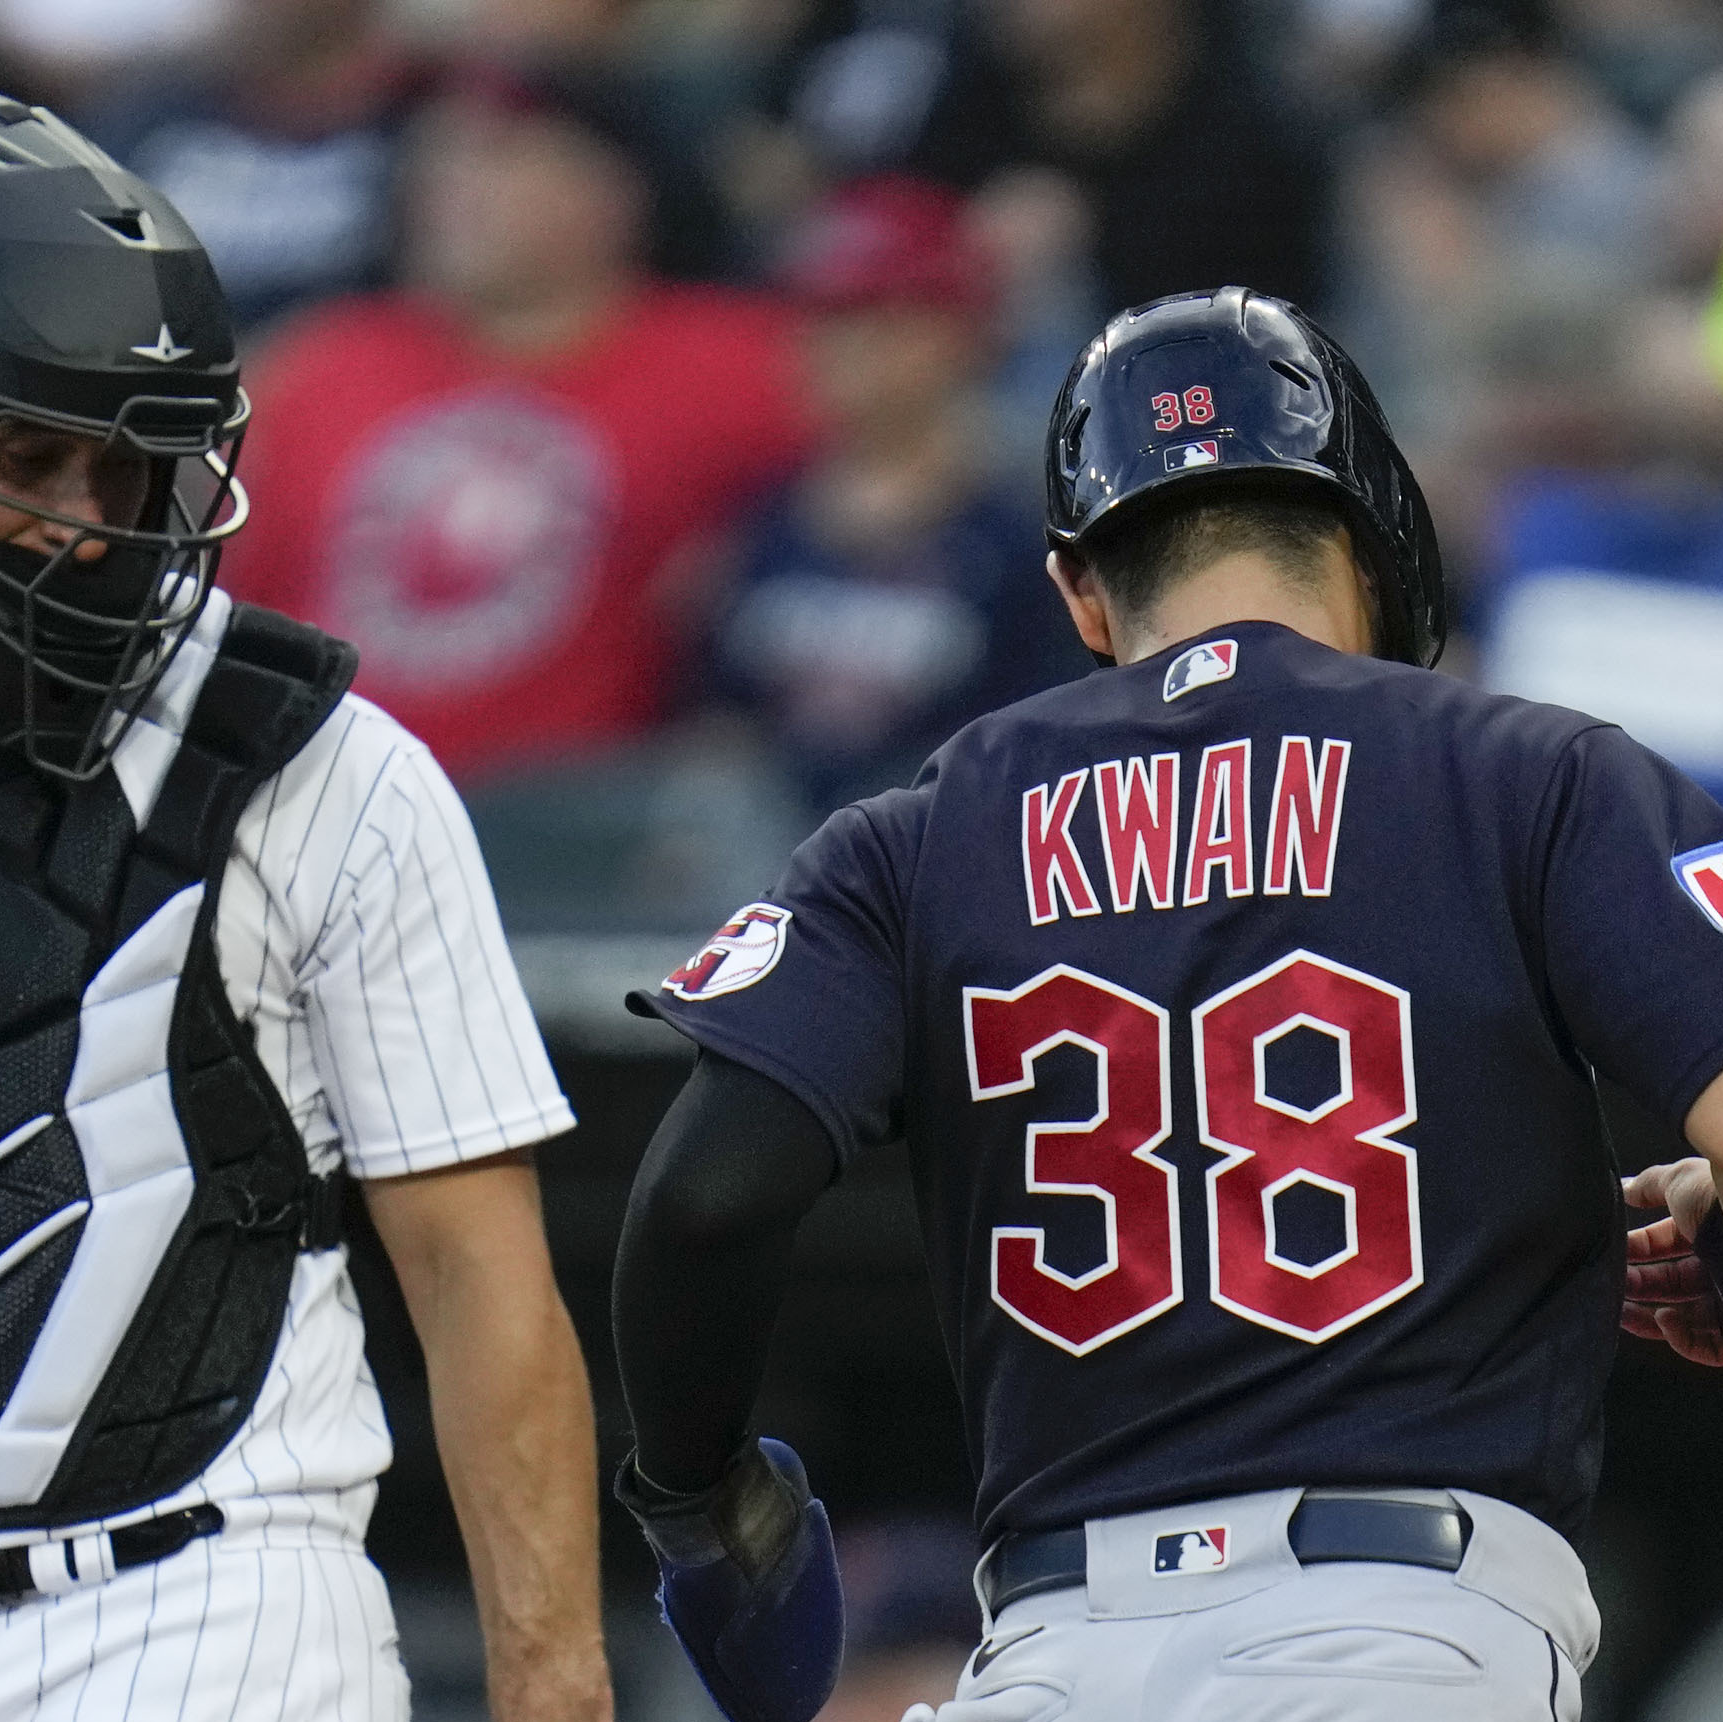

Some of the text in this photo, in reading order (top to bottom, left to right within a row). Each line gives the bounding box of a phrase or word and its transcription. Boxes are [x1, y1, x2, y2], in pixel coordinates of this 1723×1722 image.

[1151, 384, 1216, 431] 38
[1022, 735, 1353, 926] KWAN
[962, 947, 1425, 1358] 38
